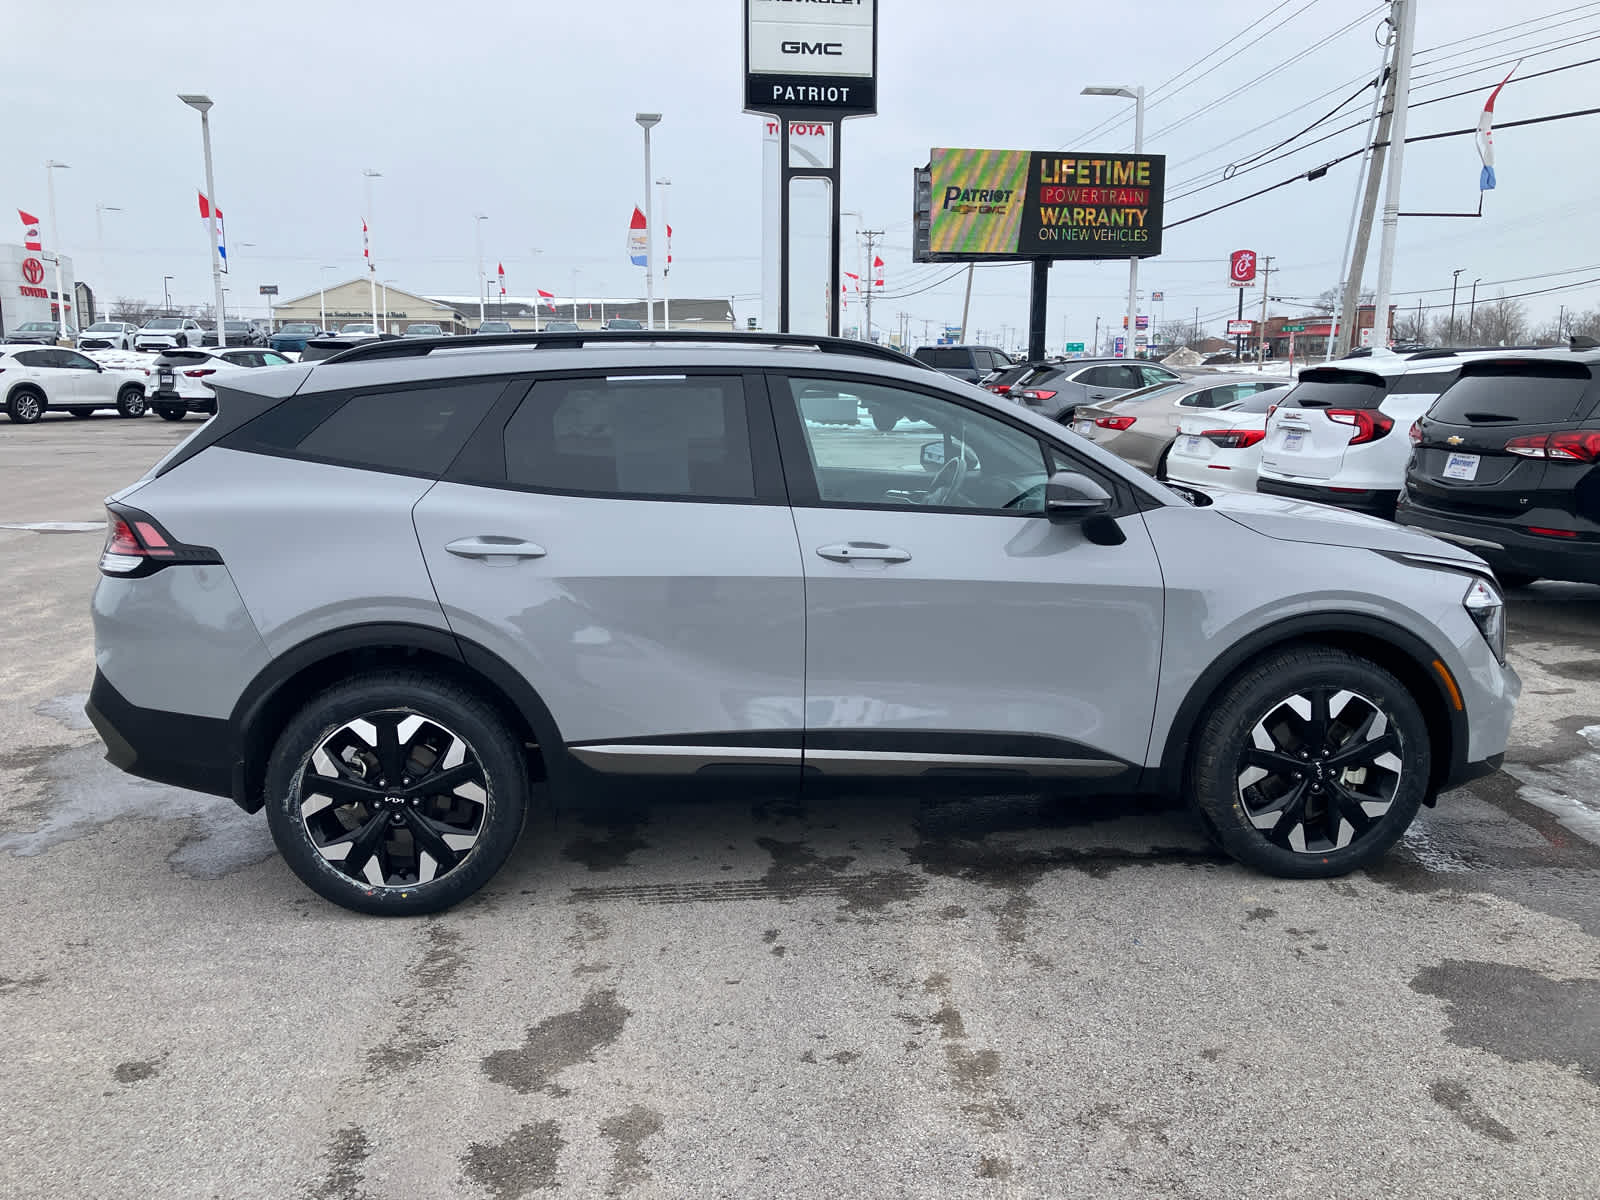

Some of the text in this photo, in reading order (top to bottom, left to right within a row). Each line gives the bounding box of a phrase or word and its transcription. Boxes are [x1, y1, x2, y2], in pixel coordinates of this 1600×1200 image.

[781, 41, 842, 56] GMC
[773, 85, 850, 102] PATRIOT
[766, 123, 825, 136] TYOTA
[1040, 158, 1151, 185] LIFETIME
[943, 186, 1014, 209] PATRIOT
[1046, 189, 1144, 204] POWERTRAIN
[1040, 207, 1148, 227] WARRANTY
[1039, 228, 1148, 242] ON NEW VEHICLES
[18, 286, 49, 298] TOYOTA
